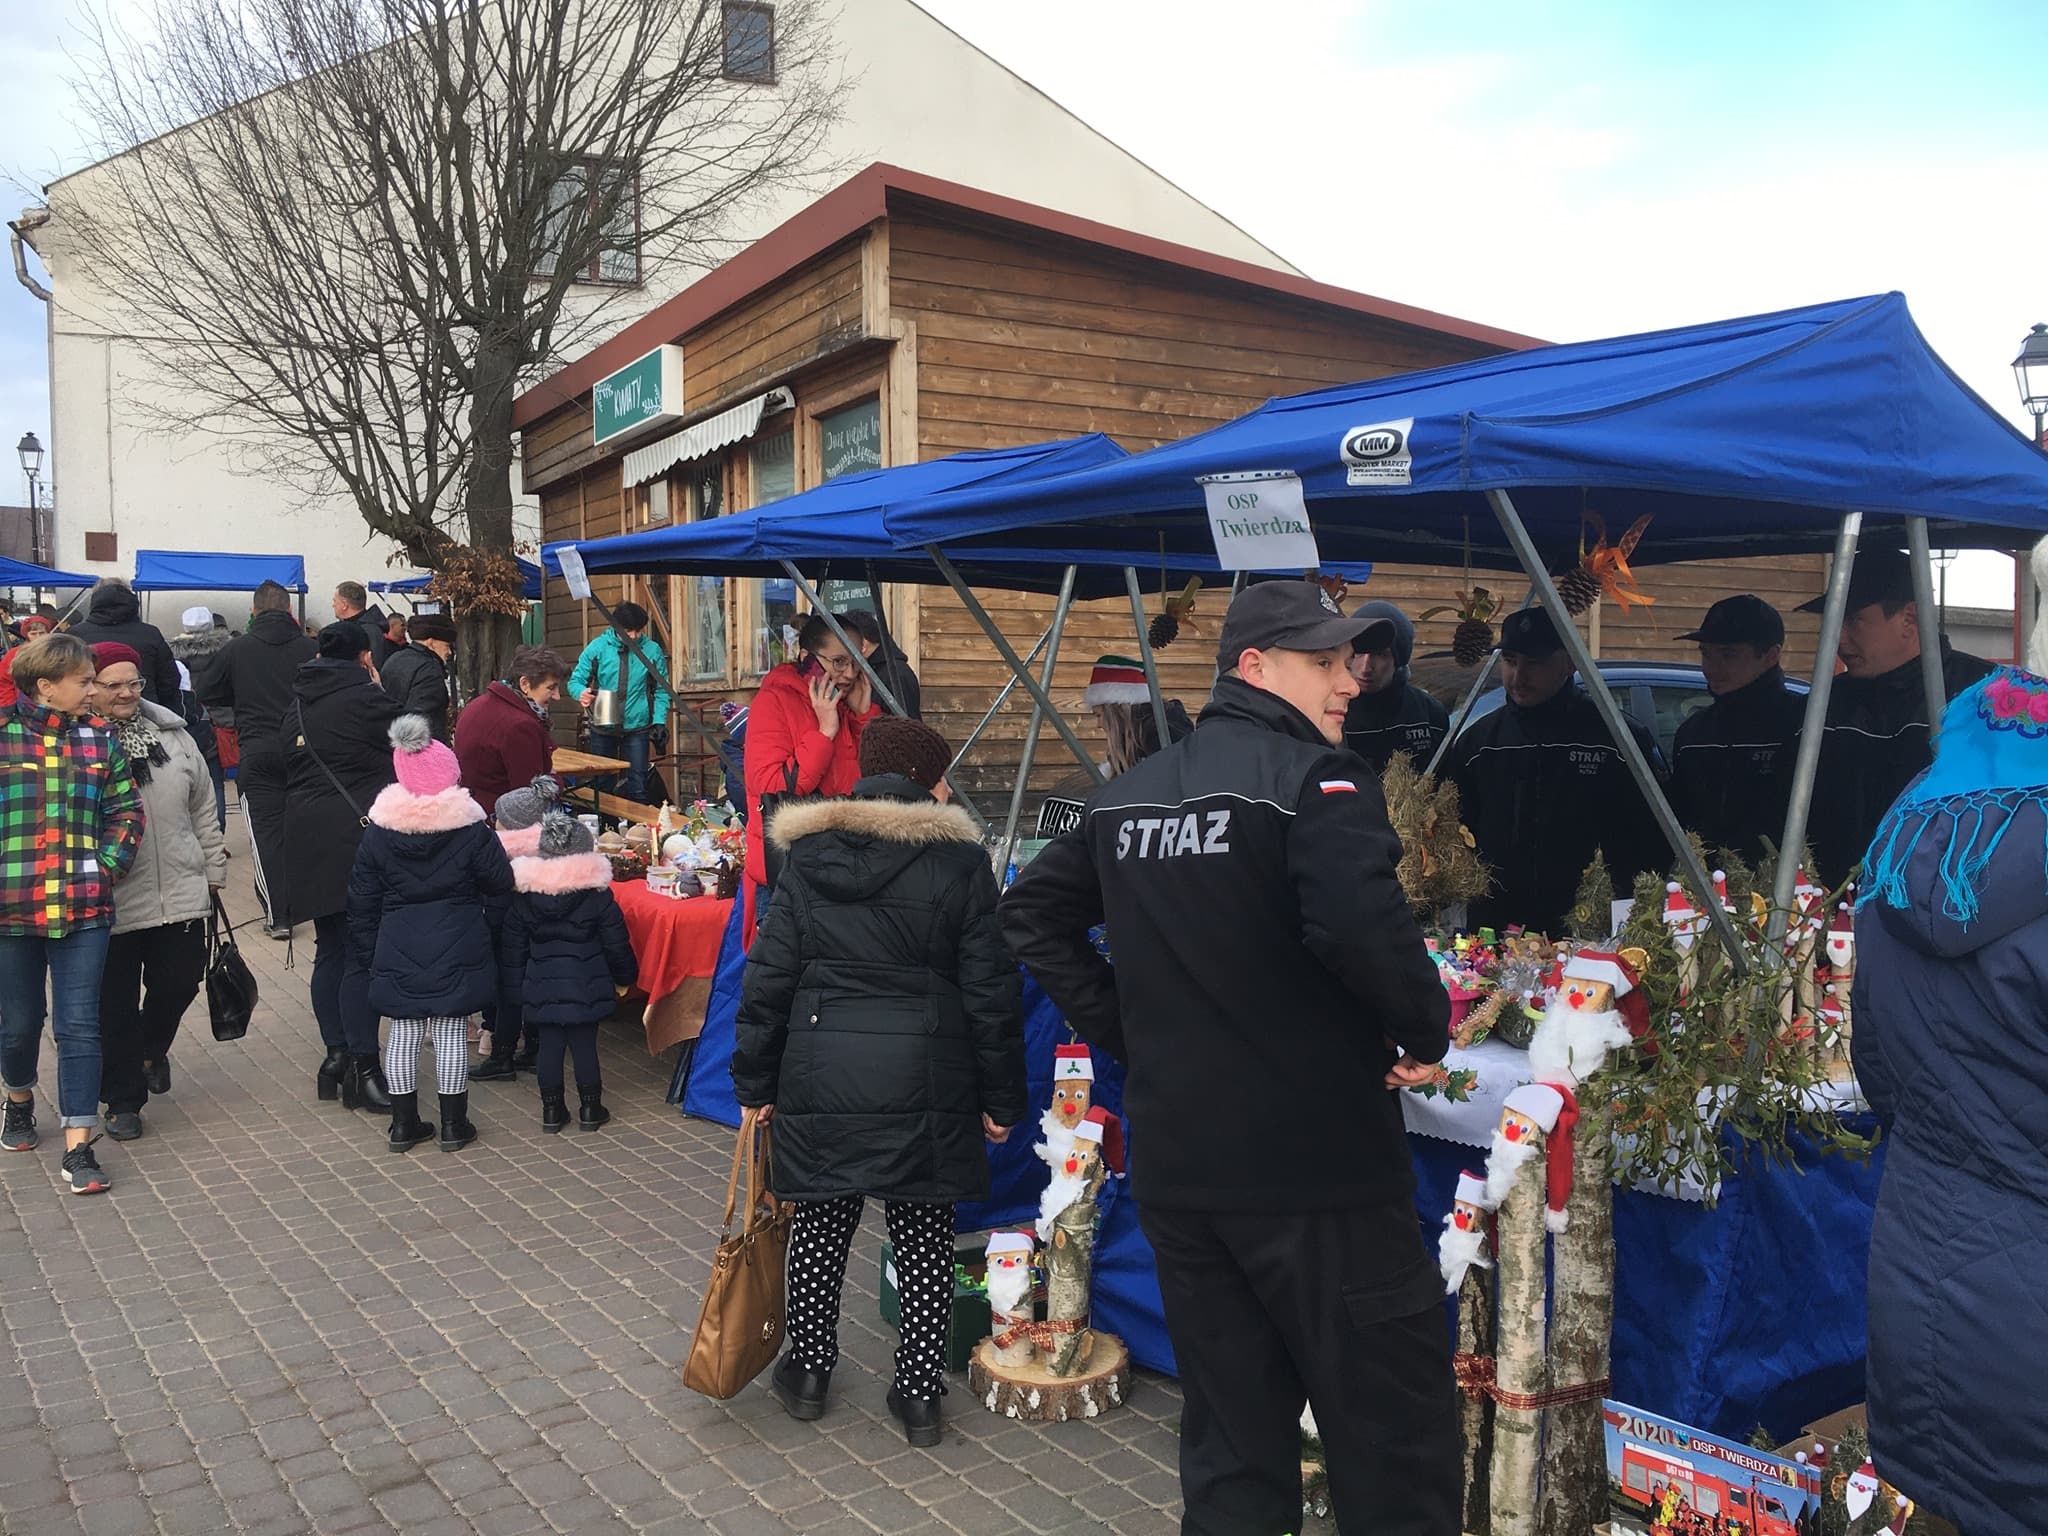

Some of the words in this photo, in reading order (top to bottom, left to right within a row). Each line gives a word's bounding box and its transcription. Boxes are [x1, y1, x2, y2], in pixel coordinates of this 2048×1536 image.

[1360, 437, 1390, 451] MM
[1227, 493, 1258, 510] OSP
[1216, 516, 1305, 538] Twierdza
[1617, 1412, 1671, 1446] 2020
[1692, 1440, 1717, 1455] OSP
[1718, 1447, 1778, 1478] TWIERDZA
